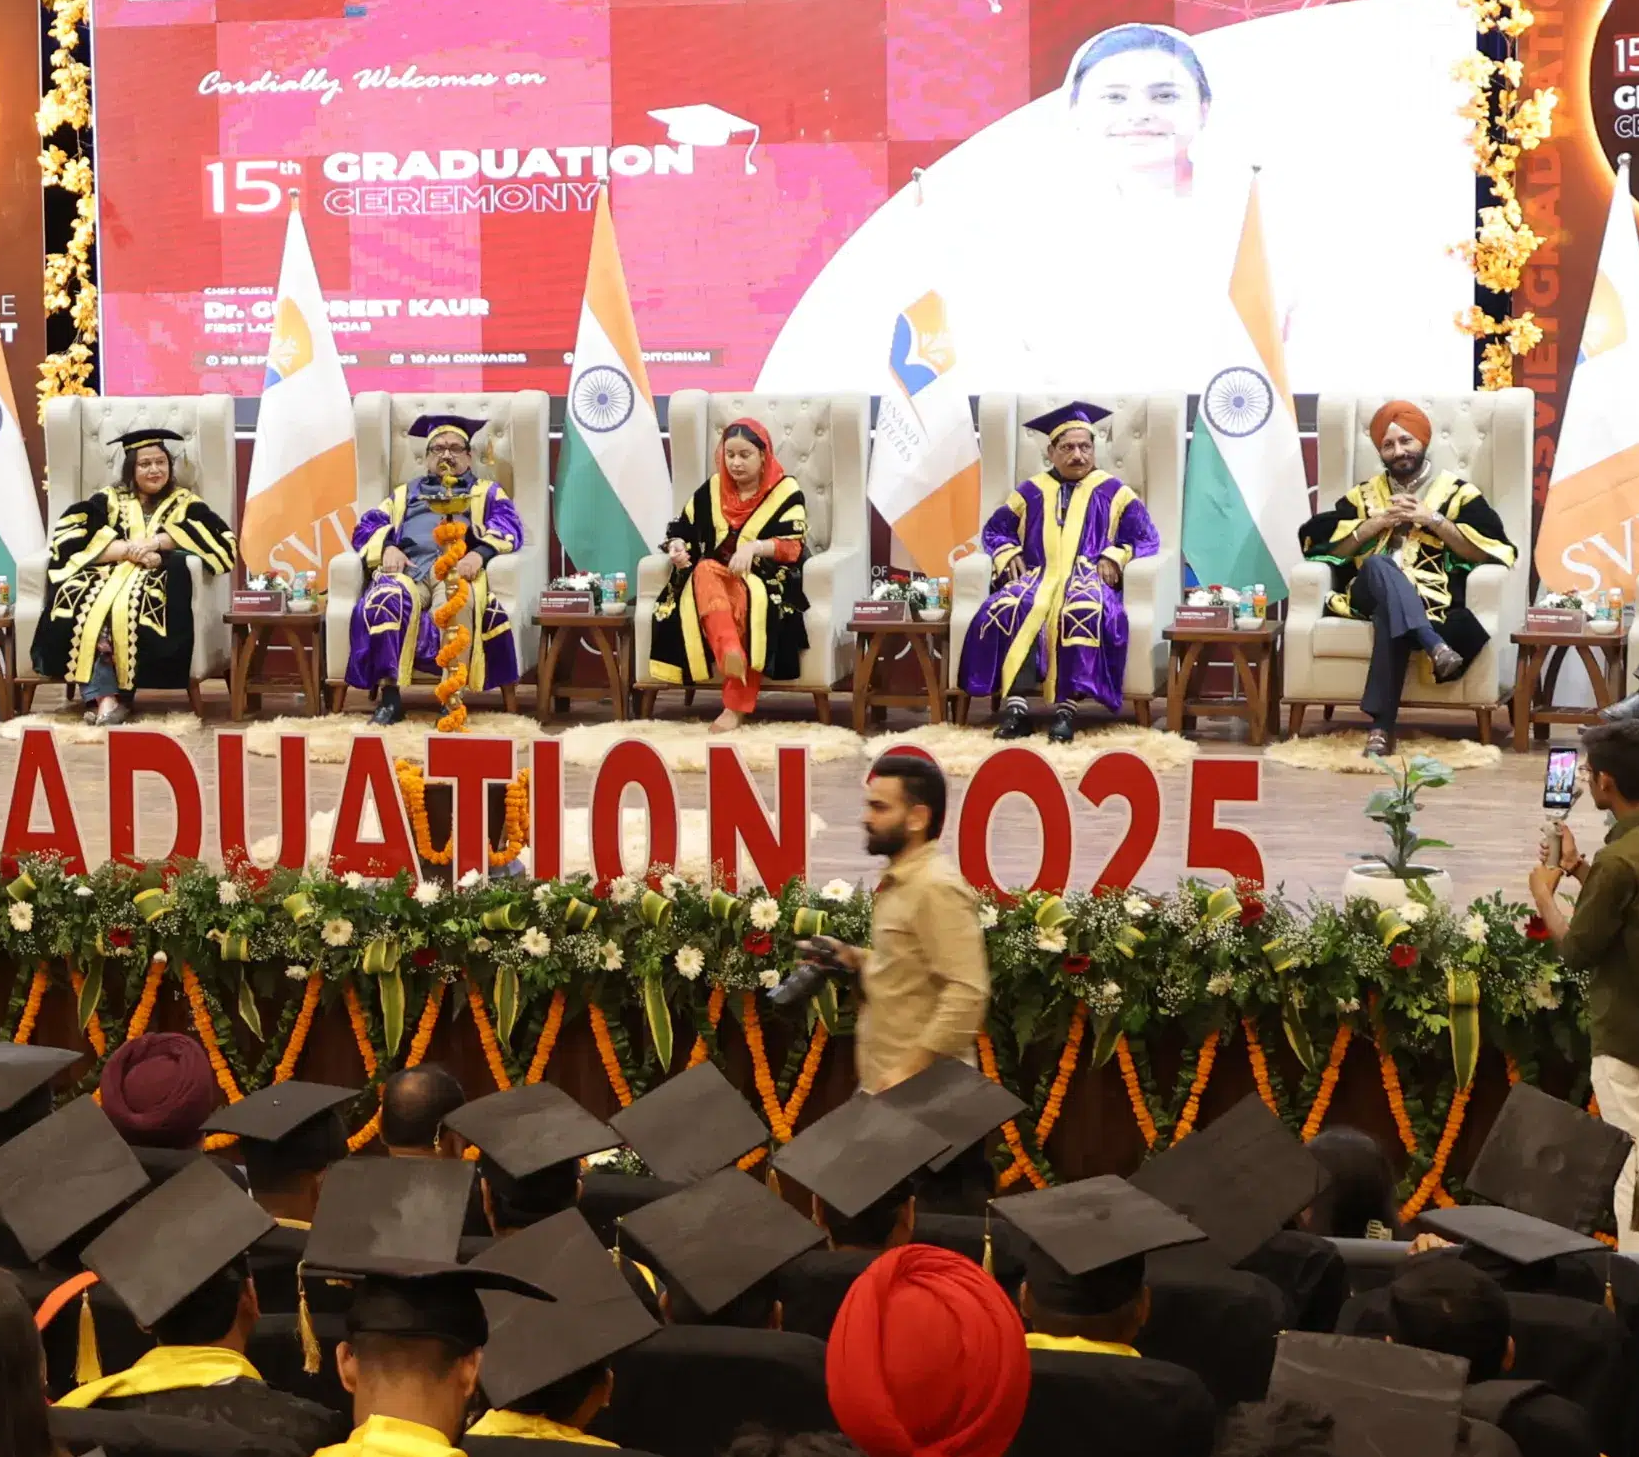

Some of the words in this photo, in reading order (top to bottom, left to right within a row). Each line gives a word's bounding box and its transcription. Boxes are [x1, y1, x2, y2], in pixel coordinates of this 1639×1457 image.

[197, 67, 344, 106] Cordially
[353, 64, 499, 91] Welcomes
[505, 71, 547, 86] on
[323, 144, 695, 183] GRADUATION
[204, 158, 302, 214] 15th
[323, 181, 599, 217] CEREMONY
[204, 301, 245, 319] Dr.
[408, 298, 490, 317] KAUR
[204, 323, 243, 333] FIRST
[247, 322, 275, 333] LAD
[641, 352, 711, 362] DITORIUM
